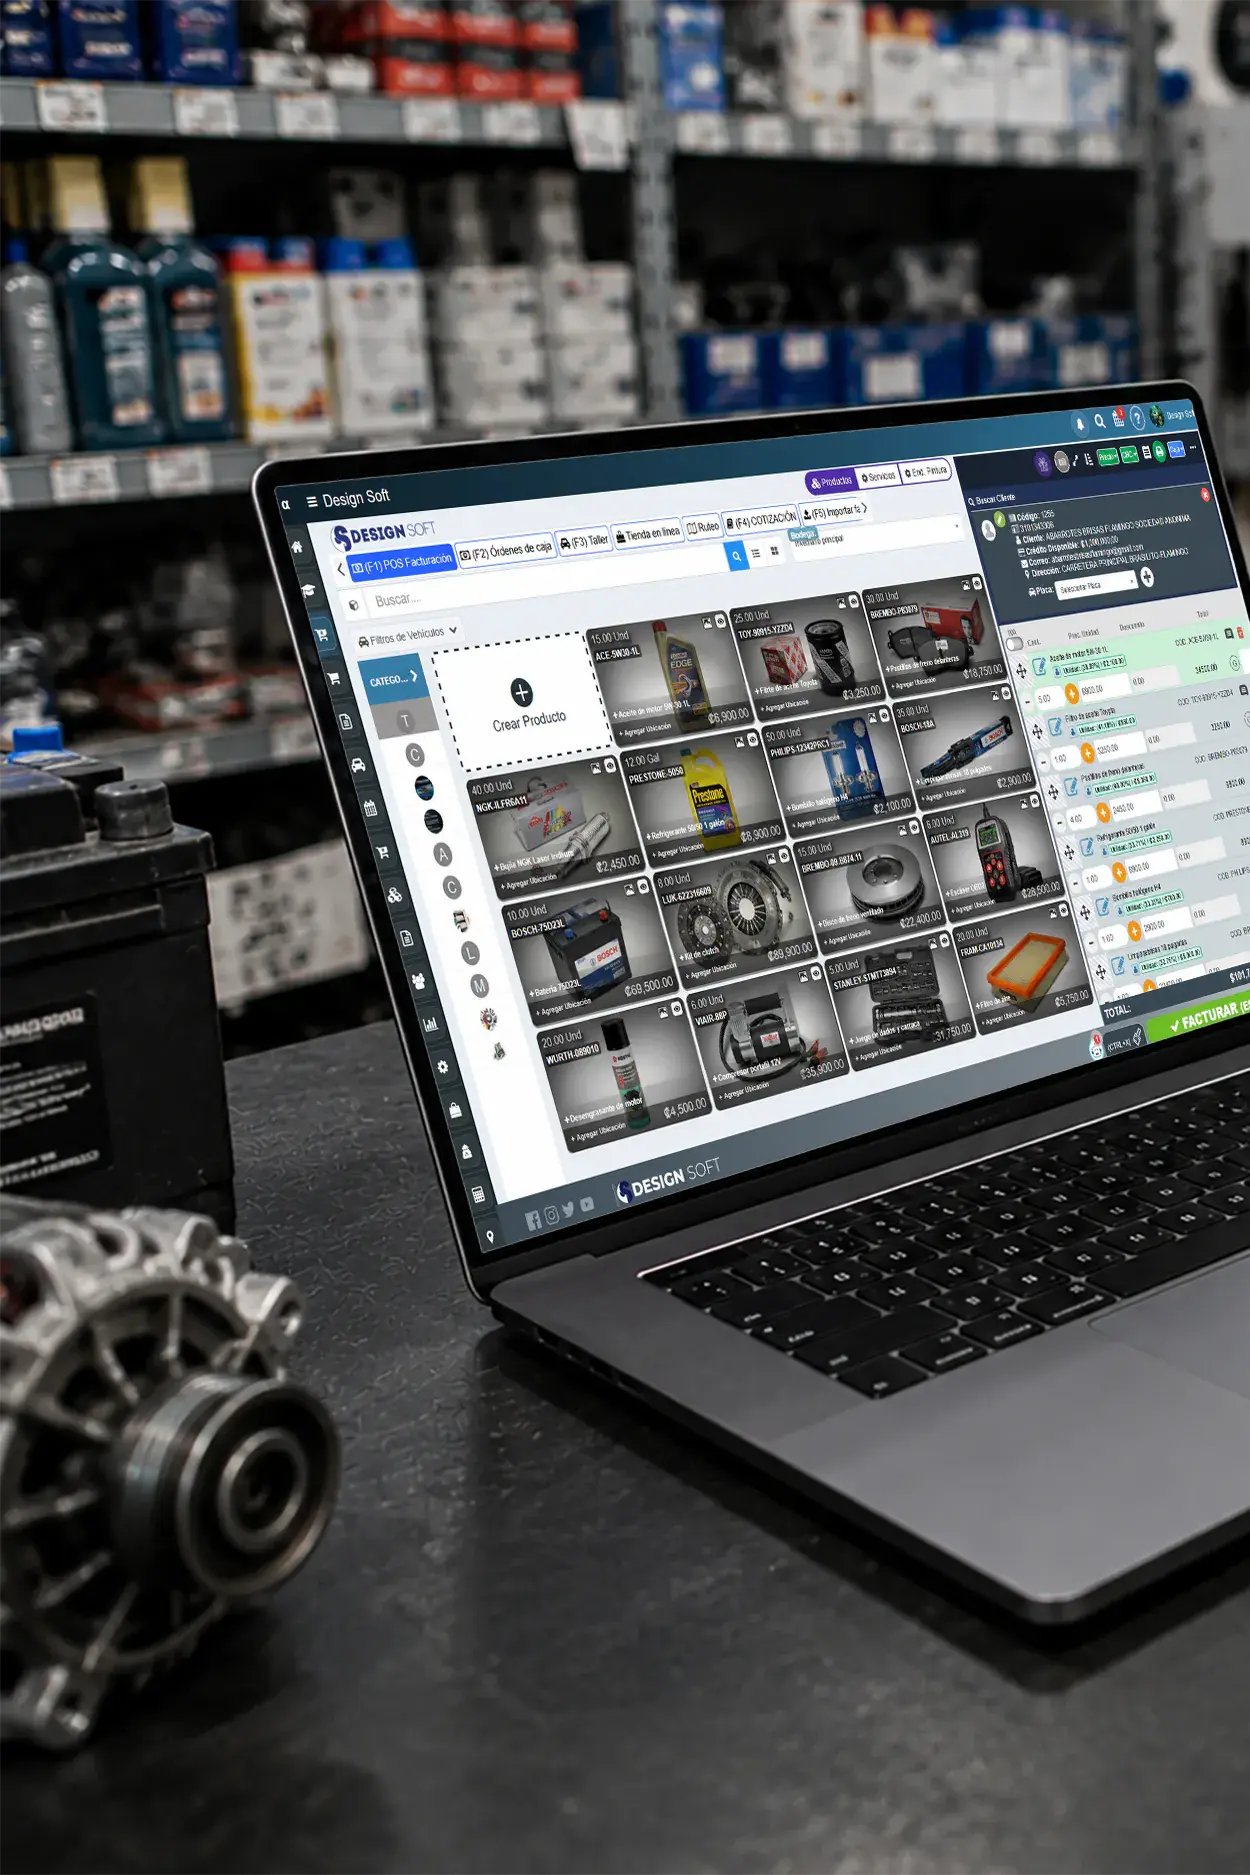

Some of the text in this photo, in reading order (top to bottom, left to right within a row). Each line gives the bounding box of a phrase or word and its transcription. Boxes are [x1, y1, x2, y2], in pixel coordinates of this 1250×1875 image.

[820, 475, 853, 487] Productos
[868, 471, 896, 482] Servicios
[322, 488, 390, 508] Design Soft
[995, 492, 1016, 502] Cliente
[734, 510, 797, 529] (F4) COTIZACIÓN
[811, 508, 827, 520] (F5)
[1016, 510, 1040, 522] Código:
[349, 520, 437, 544] DESIGN SOFT
[697, 520, 720, 532] Ruteo
[570, 533, 609, 549] (F3) Taller
[625, 528, 651, 541] Tienda
[651, 530, 661, 538] en
[1022, 533, 1044, 543] Cliente:
[471, 540, 553, 561] (F2) Órdenes de caja
[1025, 540, 1080, 555] Crédito Disponible:
[363, 551, 452, 574] (F1) POS Facturación
[1028, 556, 1051, 566] Correo:
[1031, 565, 1062, 577] Dirección:
[1035, 585, 1055, 595] Placa:
[754, 609, 770, 620] Und
[369, 626, 445, 646] Filtros de Vehículos
[590, 630, 630, 645] 15.00 Und
[492, 709, 566, 732] Crear Producto
[624, 752, 660, 767] 12.00 Gal
[470, 779, 513, 796] 40.00 Und
[691, 783, 725, 804] Prestone
[657, 872, 691, 888] 8.00 Und
[506, 903, 548, 921] 10.00 Und
[594, 944, 620, 962] BOSCH
[690, 993, 724, 1010] 6.00 Und
[1103, 1002, 1131, 1019] TOTAL:
[1181, 1002, 1239, 1030] FACTURAR
[541, 1029, 583, 1048] 20.00 Und
[630, 1156, 723, 1198] DESIGN SOFT
